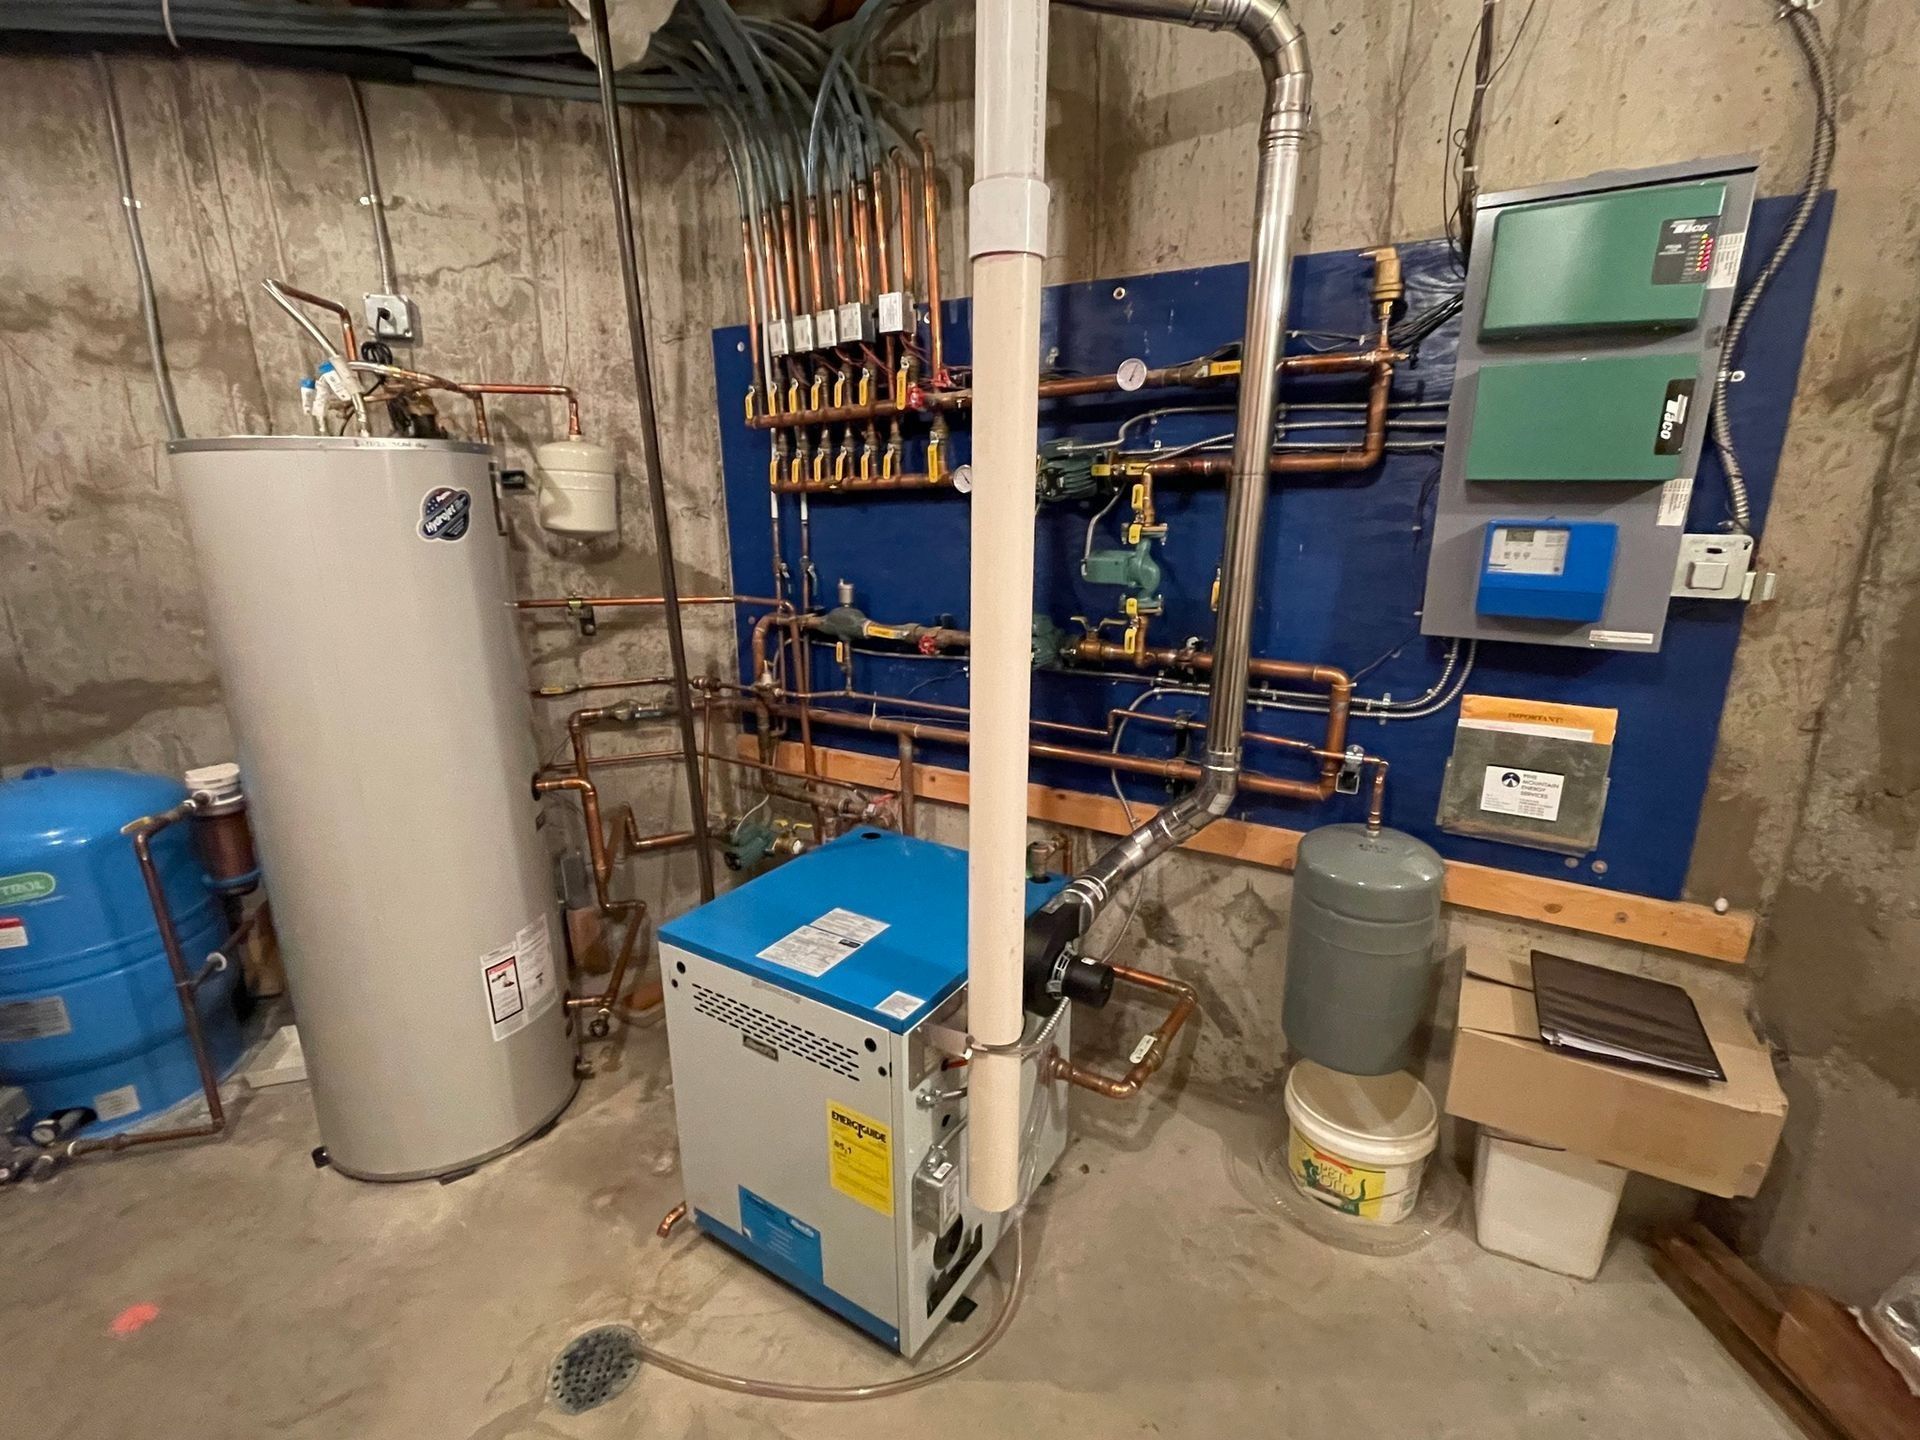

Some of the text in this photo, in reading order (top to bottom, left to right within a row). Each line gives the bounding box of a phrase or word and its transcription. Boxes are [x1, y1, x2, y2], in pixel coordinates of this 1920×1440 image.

[1660, 394, 1688, 440] Taco
[1522, 780, 1559, 789] MOUNTAIN
[1520, 791, 1549, 799] SERVICES
